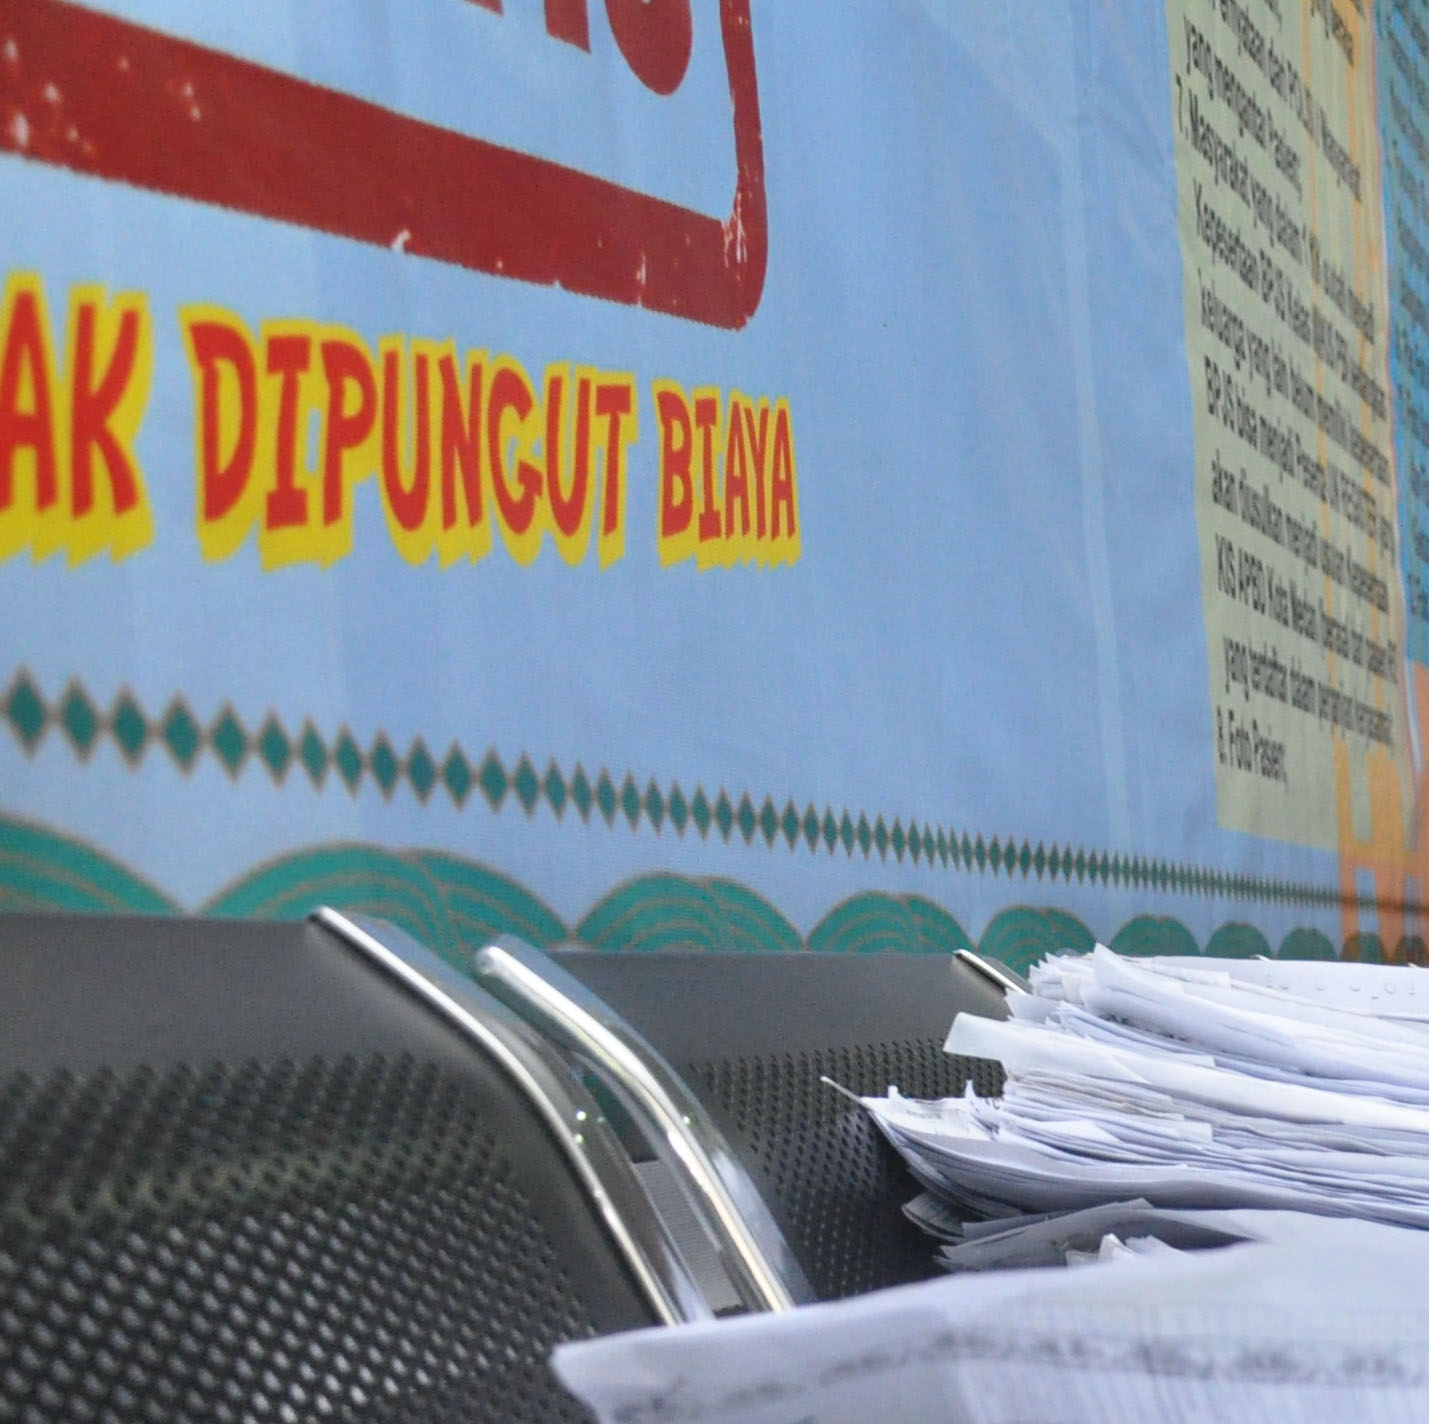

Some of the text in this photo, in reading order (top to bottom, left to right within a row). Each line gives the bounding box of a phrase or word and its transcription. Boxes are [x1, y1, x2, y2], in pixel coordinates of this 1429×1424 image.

[1259, 245, 1286, 323] BPJS
[1204, 353, 1236, 434] BPJS
[178, 303, 640, 571] DIPUNGUT
[652, 377, 801, 572] BIAYA
[1216, 533, 1237, 602] KIS
